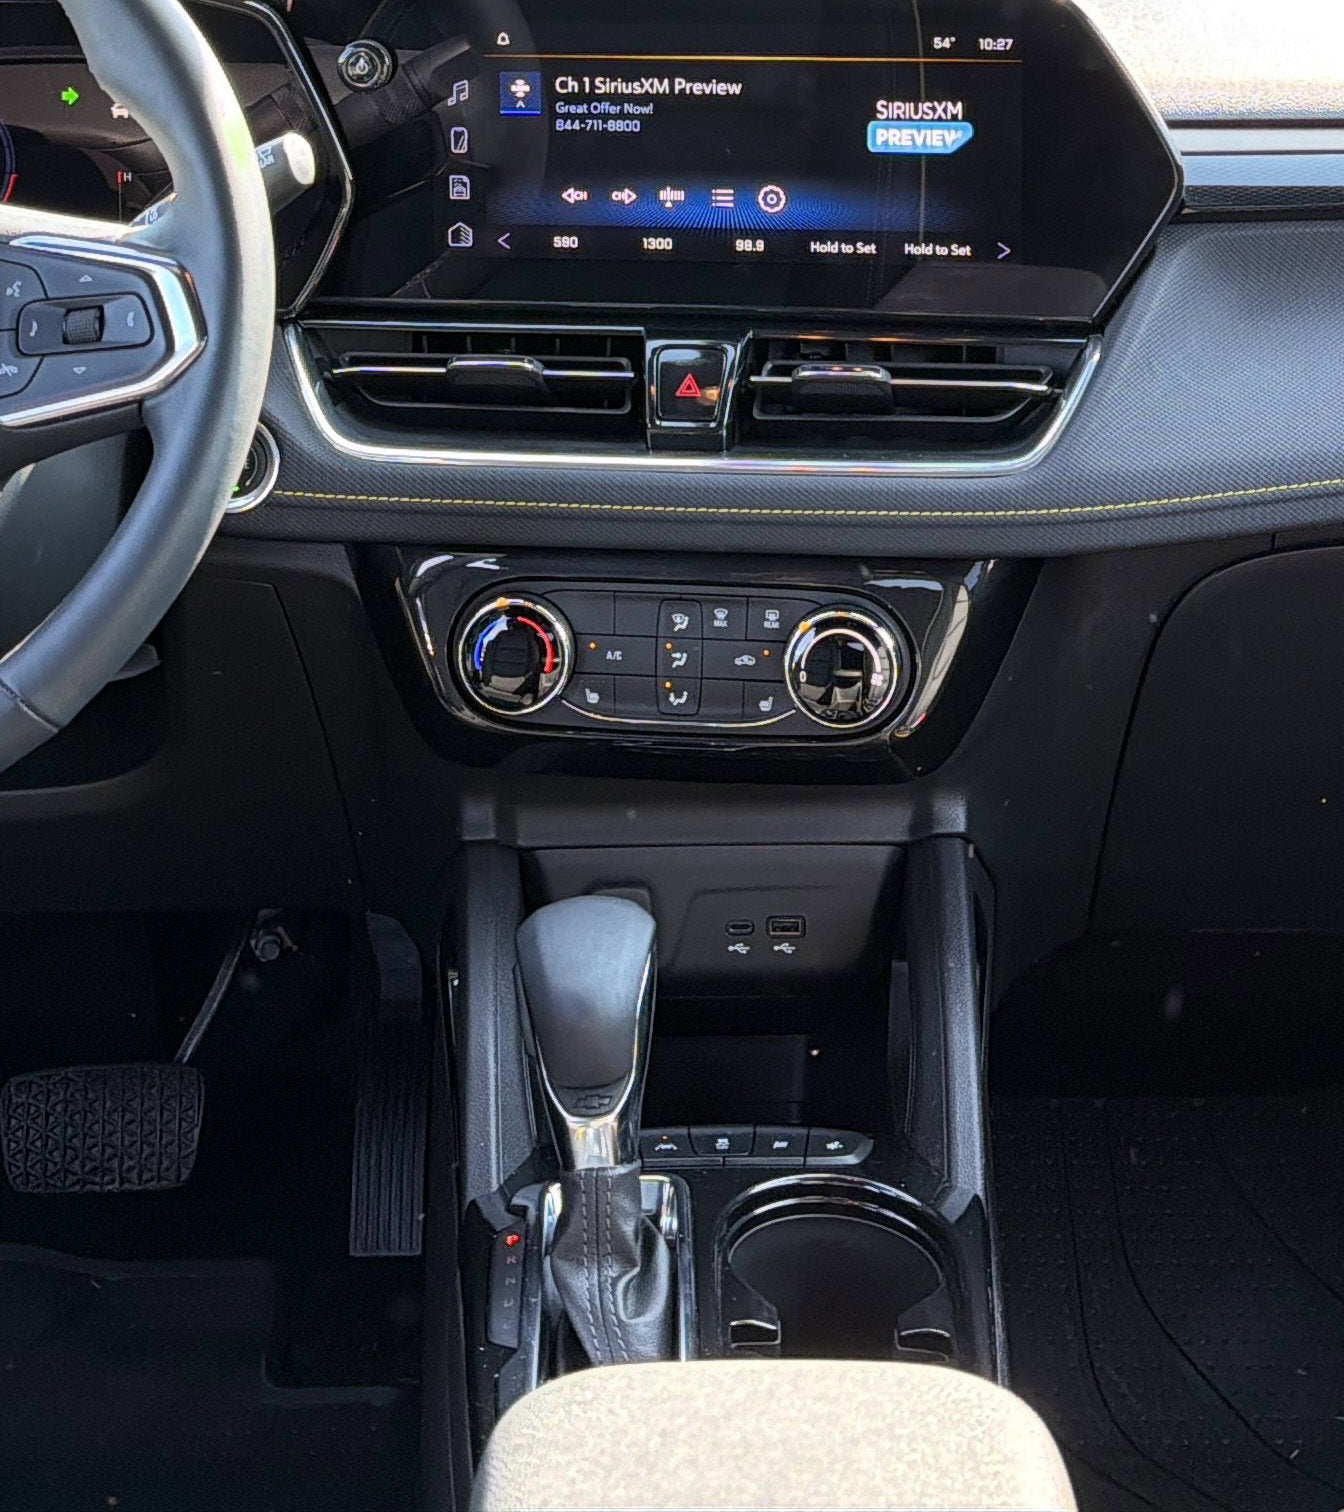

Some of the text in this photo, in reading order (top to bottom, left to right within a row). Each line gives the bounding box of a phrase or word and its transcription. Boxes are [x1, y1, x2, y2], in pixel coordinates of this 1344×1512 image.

[978, 38, 1014, 51] 10:27
[556, 76, 743, 96] Ch 1 SiriusXM Preview
[556, 102, 654, 115] Great Offer Now!
[876, 100, 963, 121] SIRIUSXM
[556, 119, 641, 133] 844-711-8800
[876, 129, 962, 148] PREVIEW
[554, 236, 578, 248] 590
[643, 237, 673, 250] 1300
[735, 239, 765, 252] 98.9
[810, 241, 877, 255] Hold to Set
[904, 243, 971, 257] Hold to Set
[606, 650, 623, 661] A/C
